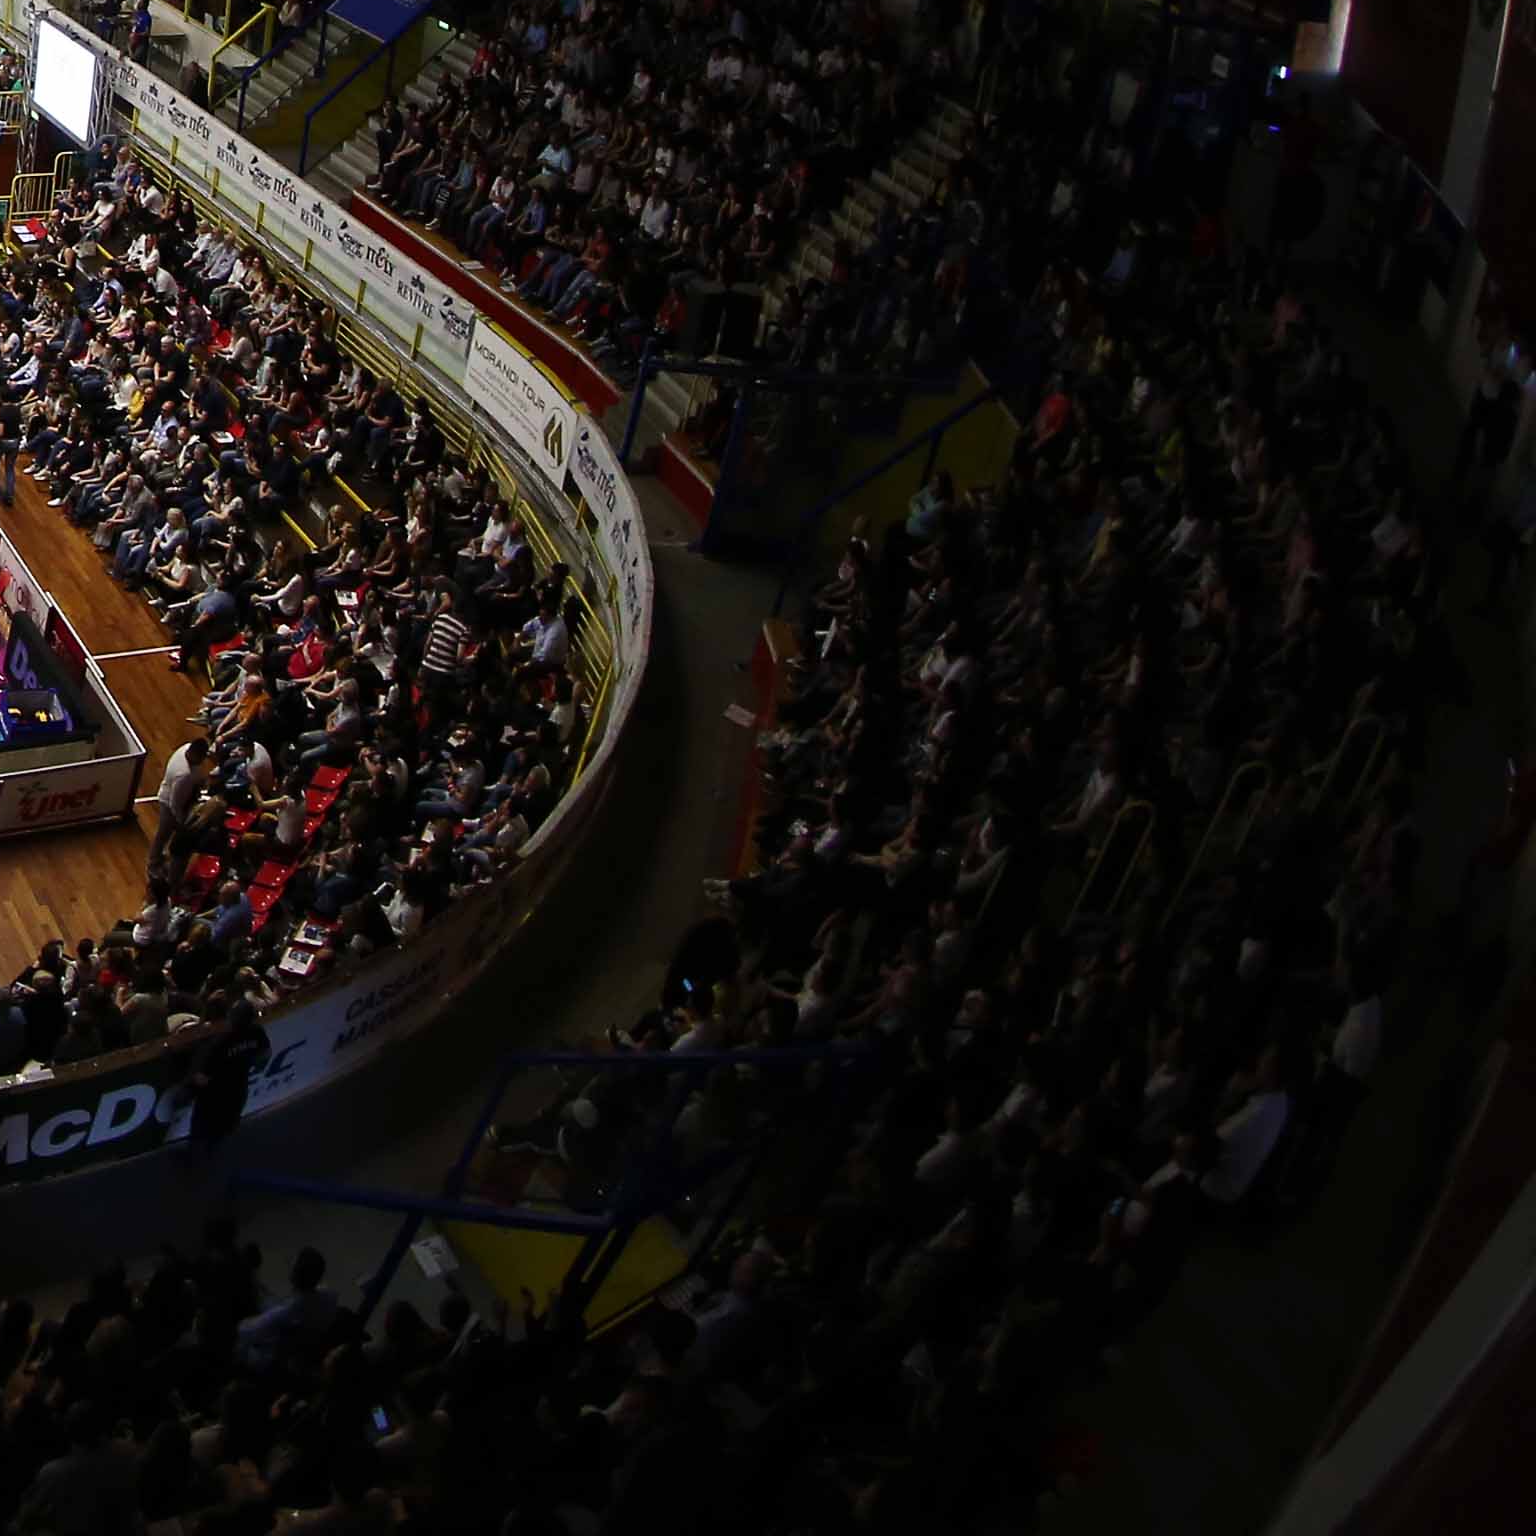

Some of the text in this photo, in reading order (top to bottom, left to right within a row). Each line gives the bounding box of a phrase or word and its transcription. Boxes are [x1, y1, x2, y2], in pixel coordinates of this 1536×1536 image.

[300, 208, 333, 243] REVIVRE
[397, 280, 435, 319] REVIVRE
[474, 343, 519, 384] MORANDI
[521, 379, 547, 410] TOUR
